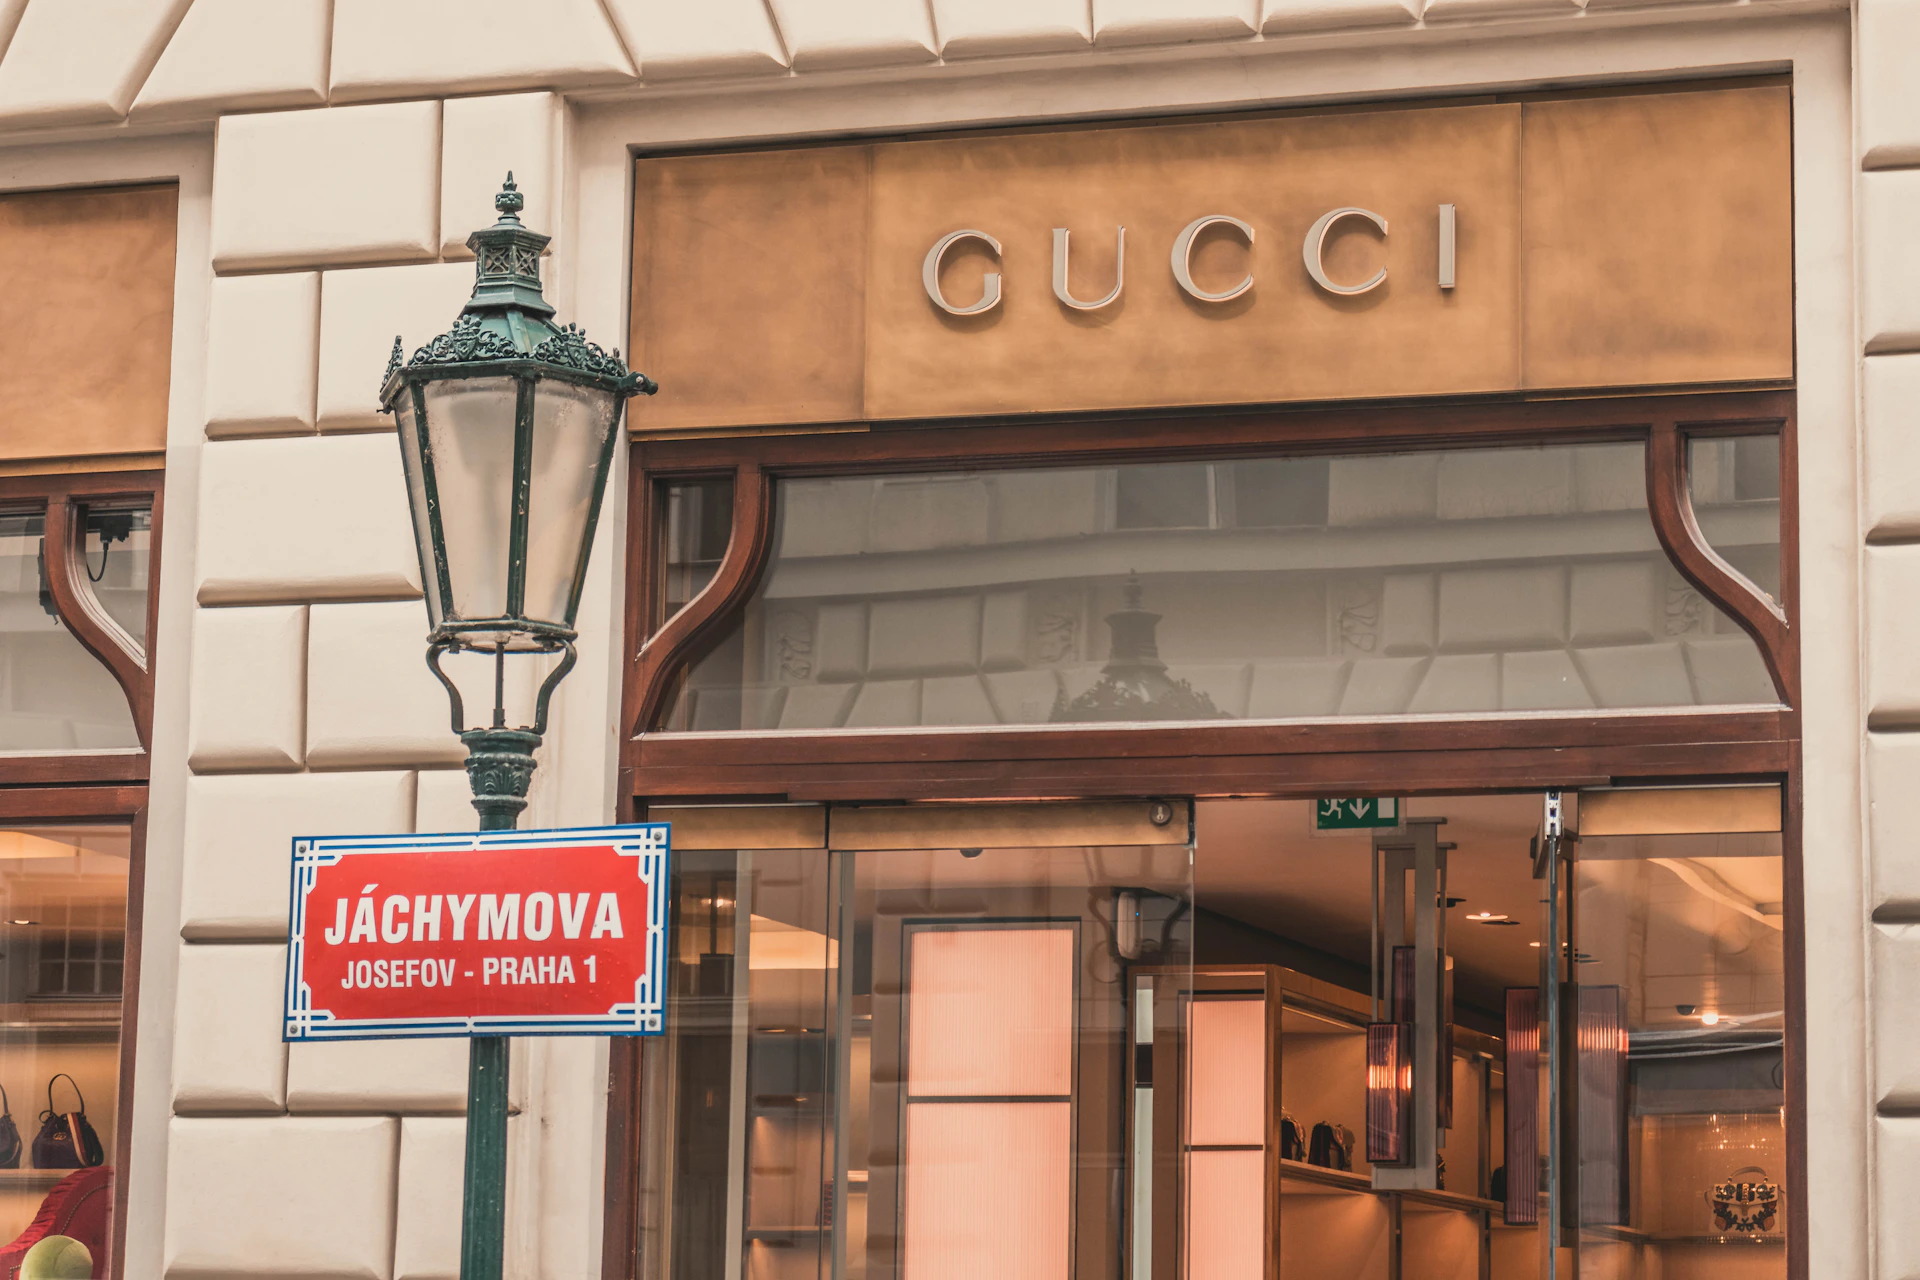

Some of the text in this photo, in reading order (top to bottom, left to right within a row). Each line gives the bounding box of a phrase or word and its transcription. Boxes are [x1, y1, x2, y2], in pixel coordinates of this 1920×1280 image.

[922, 203, 1457, 316] GUCCI
[324, 883, 624, 946] JÁCHYMOVA
[341, 958, 456, 989] JOSEFOV
[483, 955, 576, 985] PRAHA
[583, 954, 597, 983] 1
